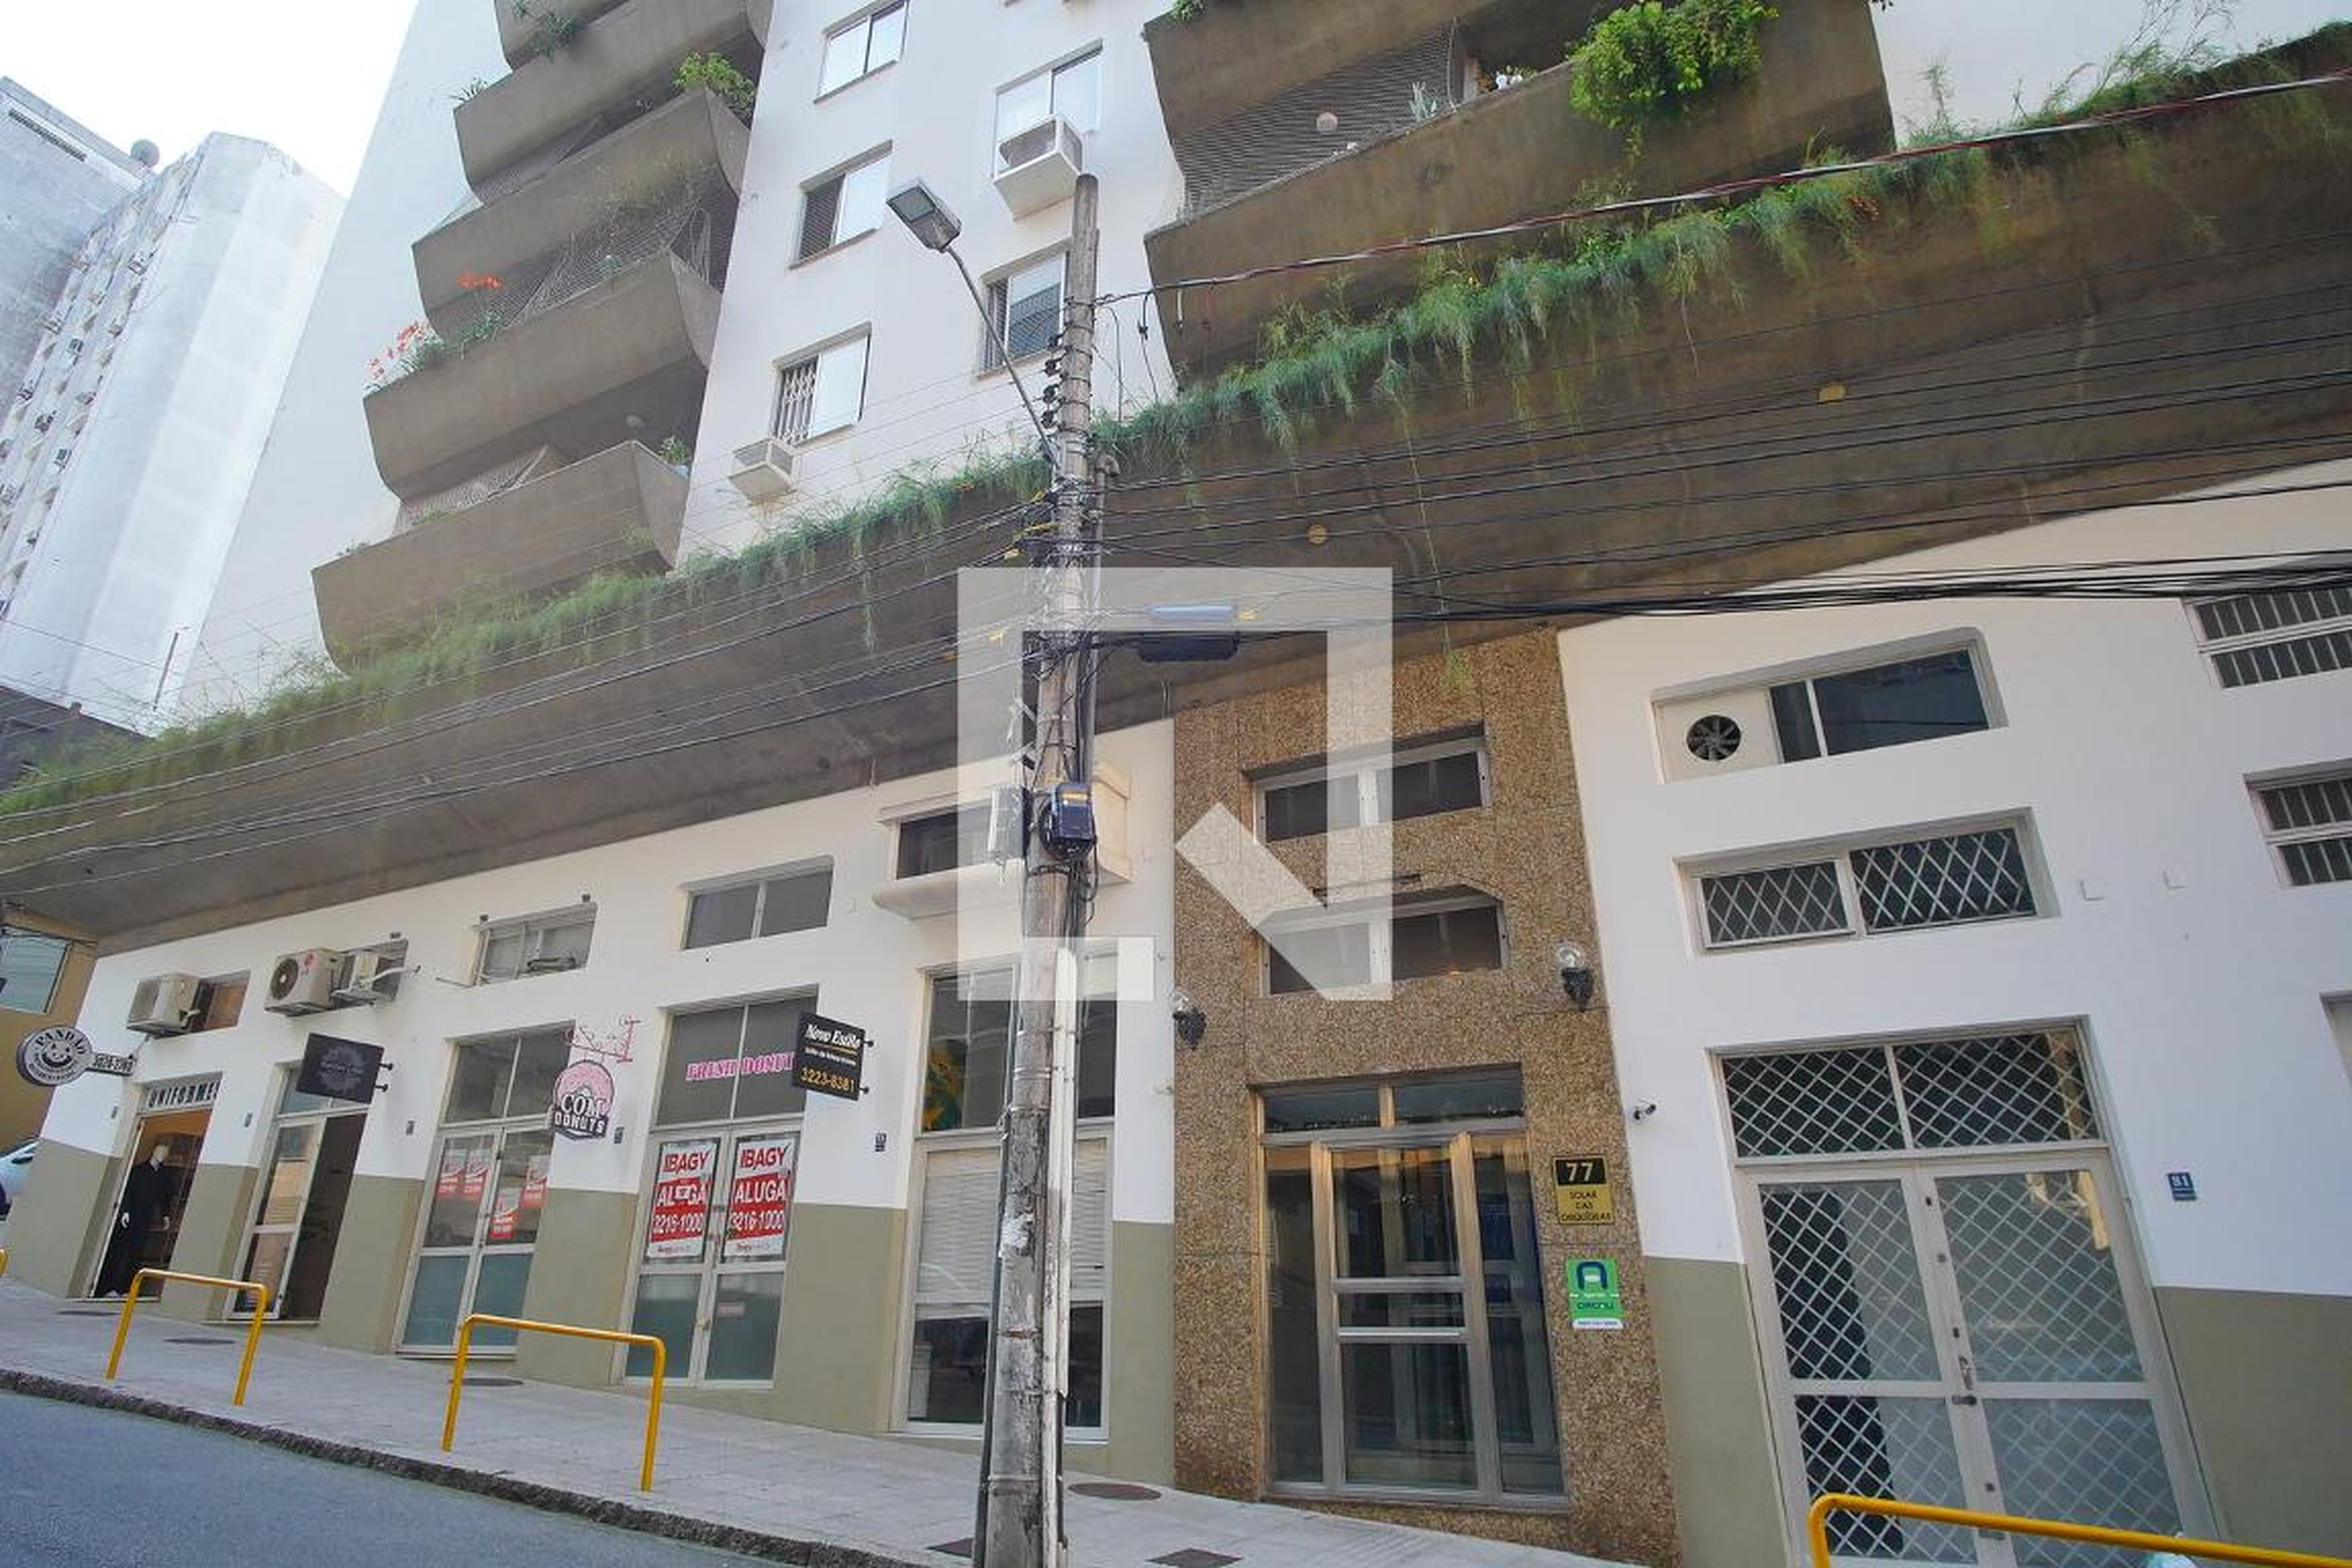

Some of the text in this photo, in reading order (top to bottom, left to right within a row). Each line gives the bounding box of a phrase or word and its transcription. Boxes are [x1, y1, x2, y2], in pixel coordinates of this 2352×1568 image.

[554, 1111, 606, 1134] DONUTS
[663, 1150, 710, 1173] IBAGY
[740, 1145, 788, 1169] IBAGY
[1566, 1162, 1593, 1182] 77
[657, 1181, 708, 1207] ALGA
[734, 1178, 786, 1204] ALUGA
